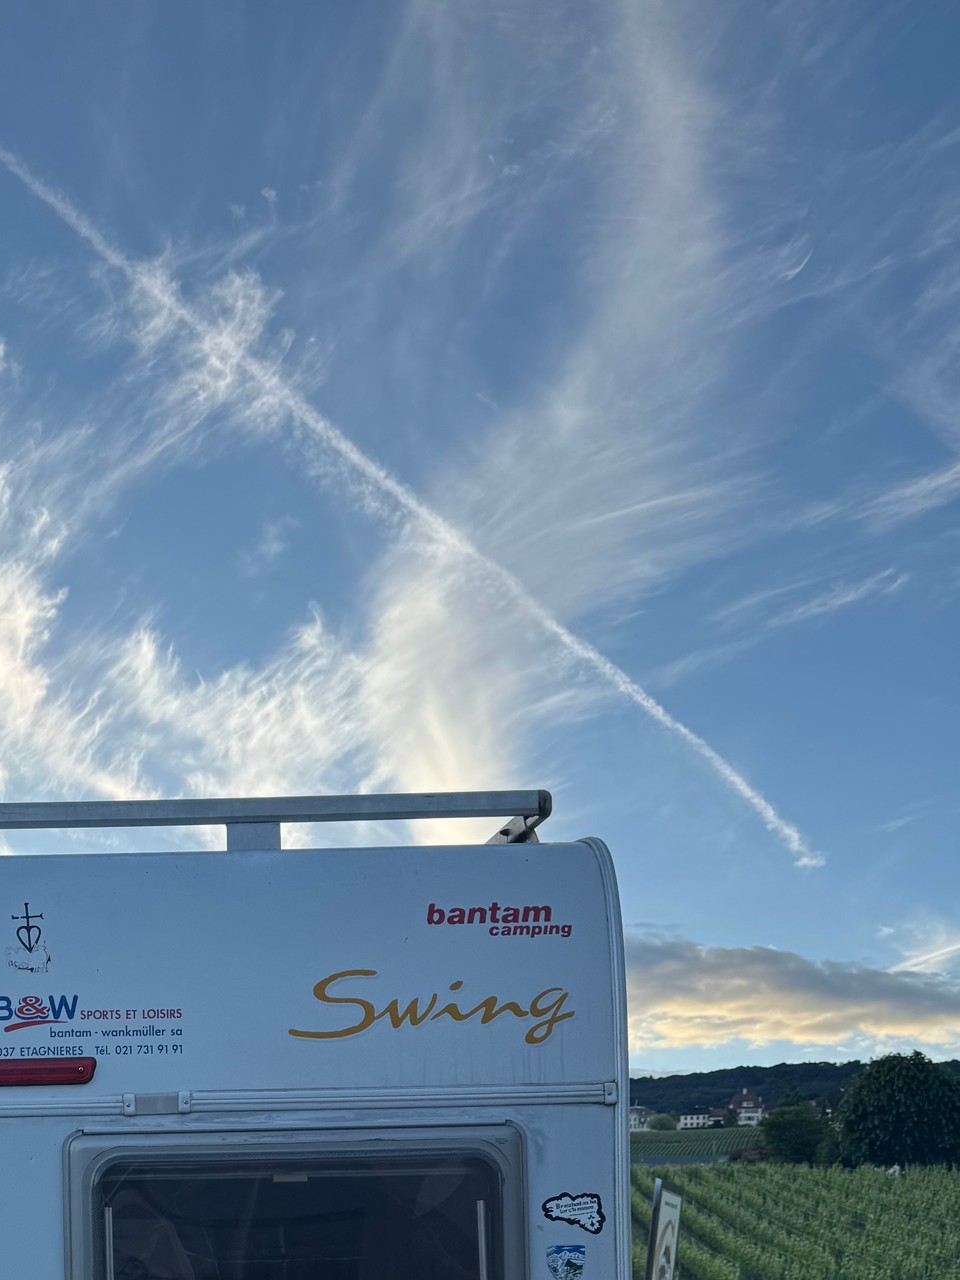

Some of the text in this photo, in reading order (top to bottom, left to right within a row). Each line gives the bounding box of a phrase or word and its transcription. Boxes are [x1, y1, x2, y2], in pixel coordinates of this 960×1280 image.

[426, 902, 552, 924] bantam
[488, 923, 573, 938] camping
[288, 968, 576, 1046] Swing
[80, 1010, 121, 1021] SPORTS
[125, 1010, 137, 1020] ET
[142, 1008, 183, 1019] LOISIRS
[49, 1027, 92, 1038] bantam
[100, 1026, 166, 1038] wankmüller
[170, 1028, 183, 1036] sa
[19, 1045, 84, 1057] ETAGNIERES
[94, 1045, 111, 1055] Tél.
[115, 1045, 133, 1055] 021
[137, 1045, 154, 1055] 731
[157, 1044, 171, 1054] 91
[172, 1044, 183, 1054] 91
